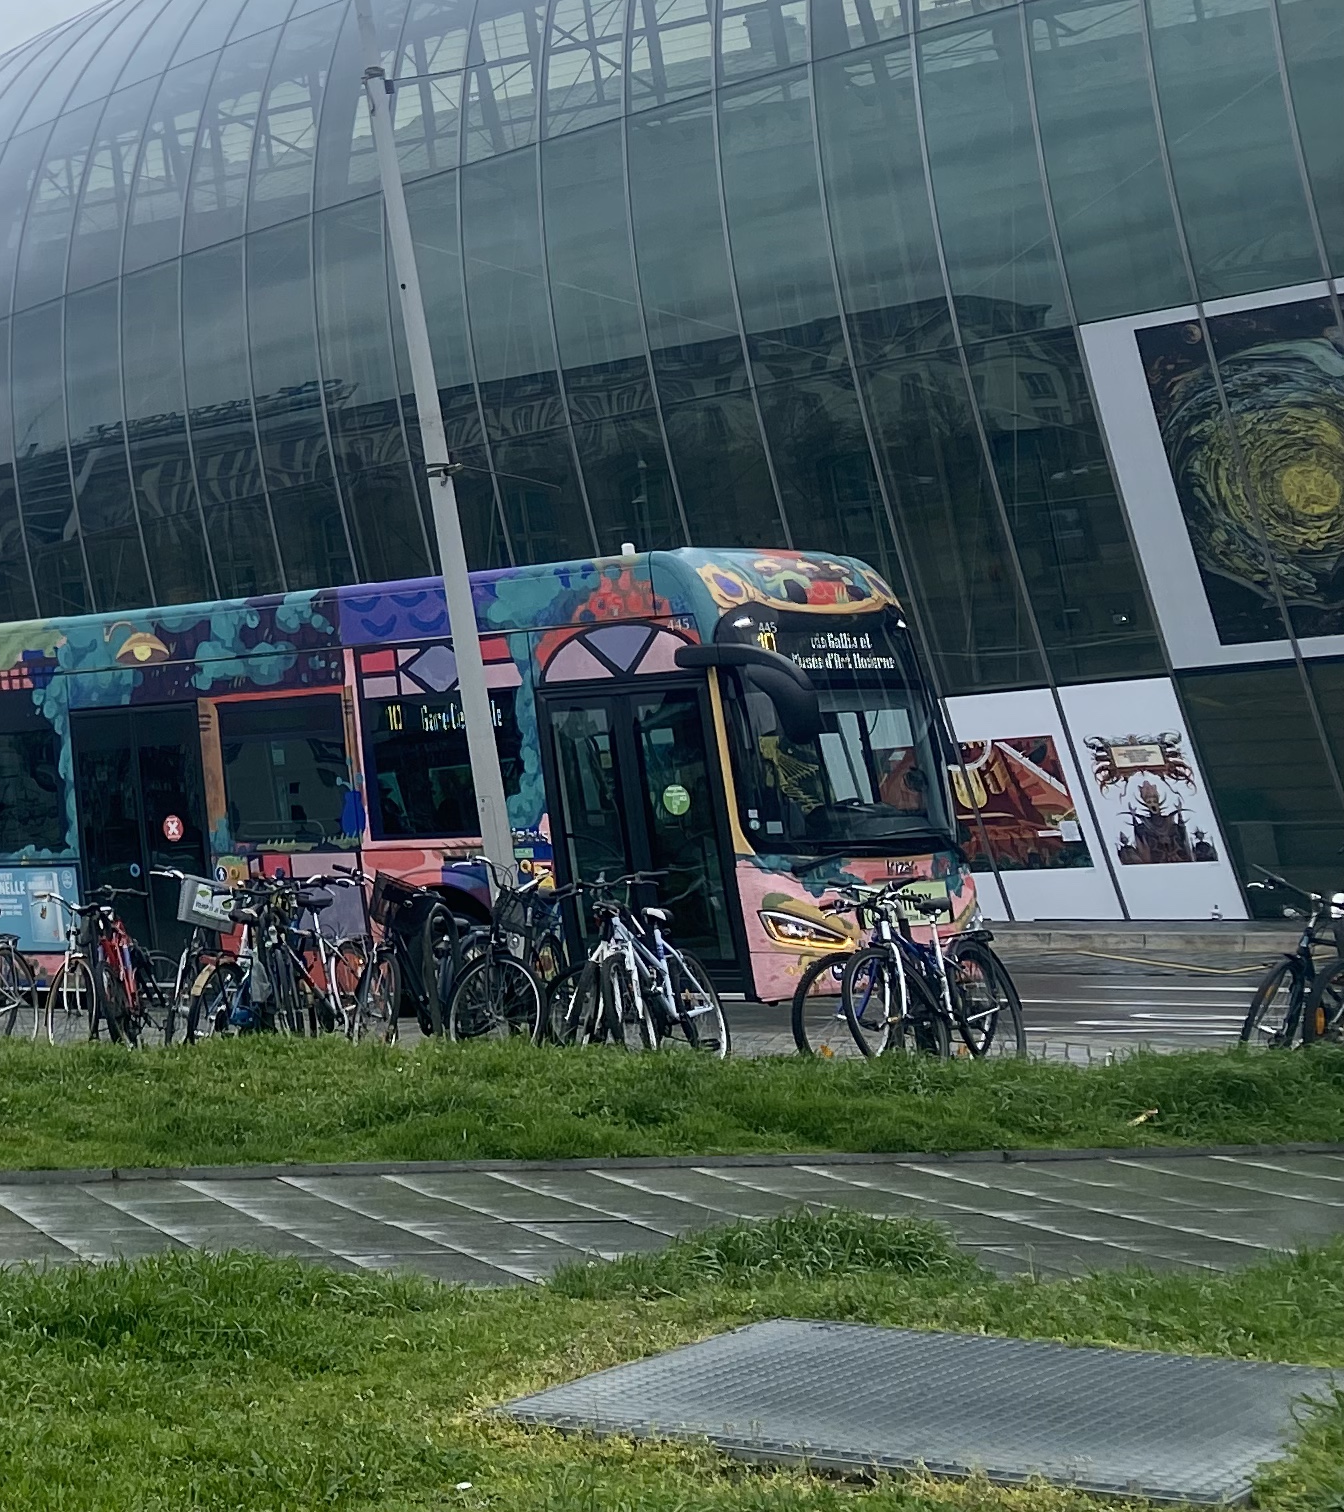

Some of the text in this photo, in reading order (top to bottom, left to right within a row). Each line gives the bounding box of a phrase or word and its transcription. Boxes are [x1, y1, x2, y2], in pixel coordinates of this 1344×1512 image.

[667, 618, 690, 630] 445
[758, 622, 778, 633] 445
[420, 704, 450, 731] Gare
